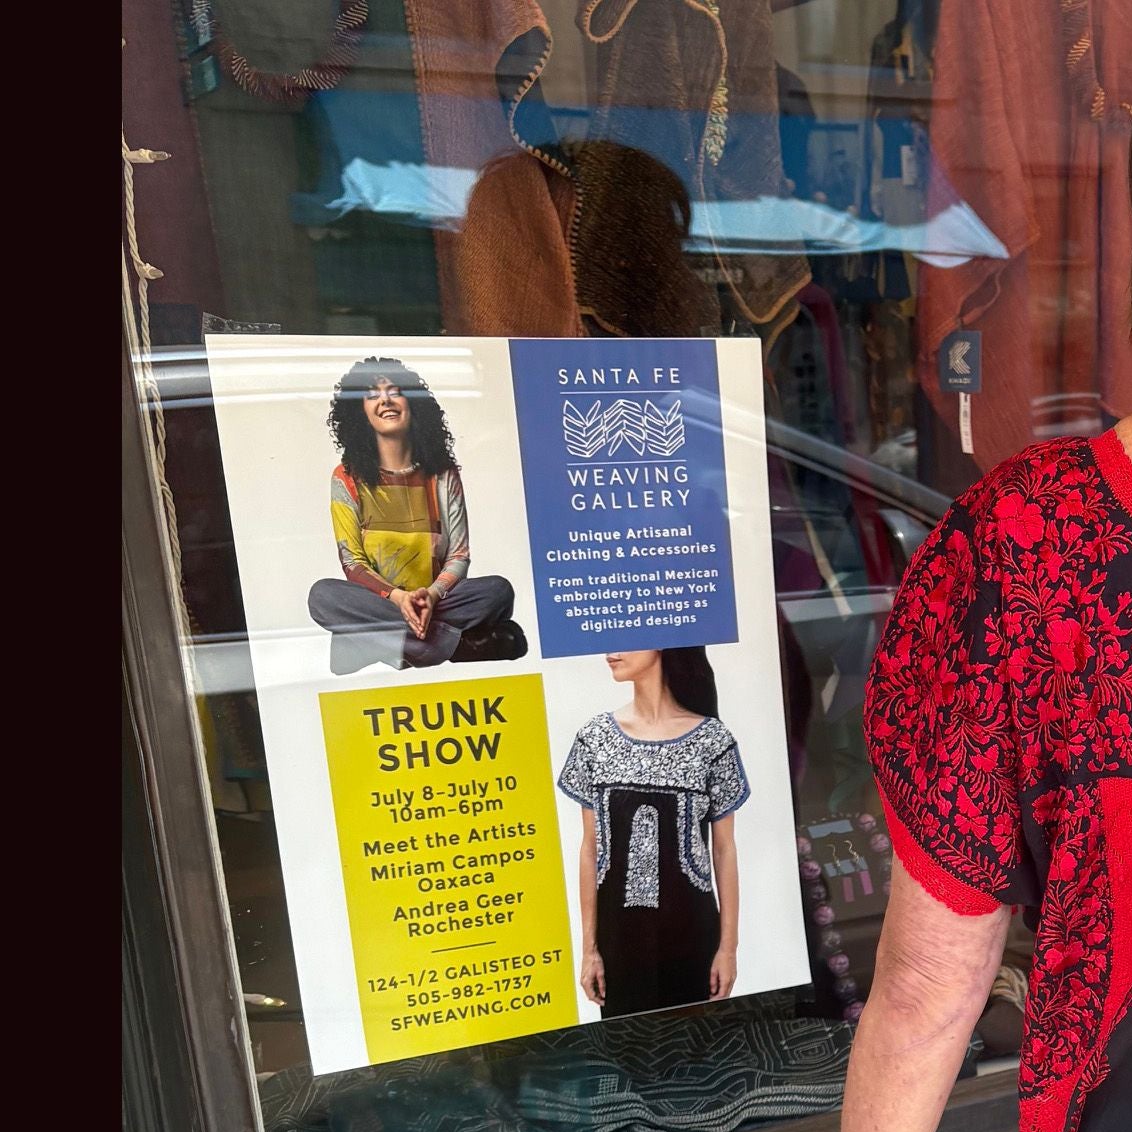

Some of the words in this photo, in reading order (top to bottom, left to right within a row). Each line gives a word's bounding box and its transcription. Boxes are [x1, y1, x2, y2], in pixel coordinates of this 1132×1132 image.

[558, 368, 640, 385] SANTA
[653, 368, 681, 384] FE
[567, 466, 689, 487] WEAVING
[571, 489, 691, 511] GALLERY
[568, 530, 621, 544] Unique
[626, 525, 692, 540] Artisanal
[546, 547, 610, 562] Clothing
[615, 547, 625, 558] &
[630, 542, 716, 557] Accessories
[549, 577, 583, 588] From
[588, 571, 660, 585] traditional
[665, 568, 719, 580] Mexican
[554, 587, 632, 603] embroidery
[637, 587, 651, 597] to
[655, 585, 684, 596] New
[688, 582, 716, 594] York
[566, 603, 623, 617] abstract
[627, 599, 690, 615] paintings
[694, 599, 708, 608] as
[581, 616, 642, 632] digitized
[646, 613, 697, 627] designs
[363, 696, 508, 736] TRUNK
[379, 733, 501, 772] SHOW
[371, 788, 414, 808] July
[496, 775, 517, 792] 10
[364, 839, 419, 857] Meet
[426, 832, 460, 849] the
[468, 822, 536, 844] Artists
[371, 860, 445, 882] Miriam
[453, 848, 535, 872] Campos
[418, 871, 495, 893] Oaxaca
[393, 900, 469, 922] Andrea
[476, 890, 524, 908] Geer
[408, 910, 515, 938] Rochester
[368, 970, 439, 993] 124-1/2
[445, 954, 536, 980] GALISTEO
[542, 949, 563, 964] ST
[407, 975, 532, 1007] 505-982-1737
[391, 992, 551, 1032] SFWEAVING.COM
